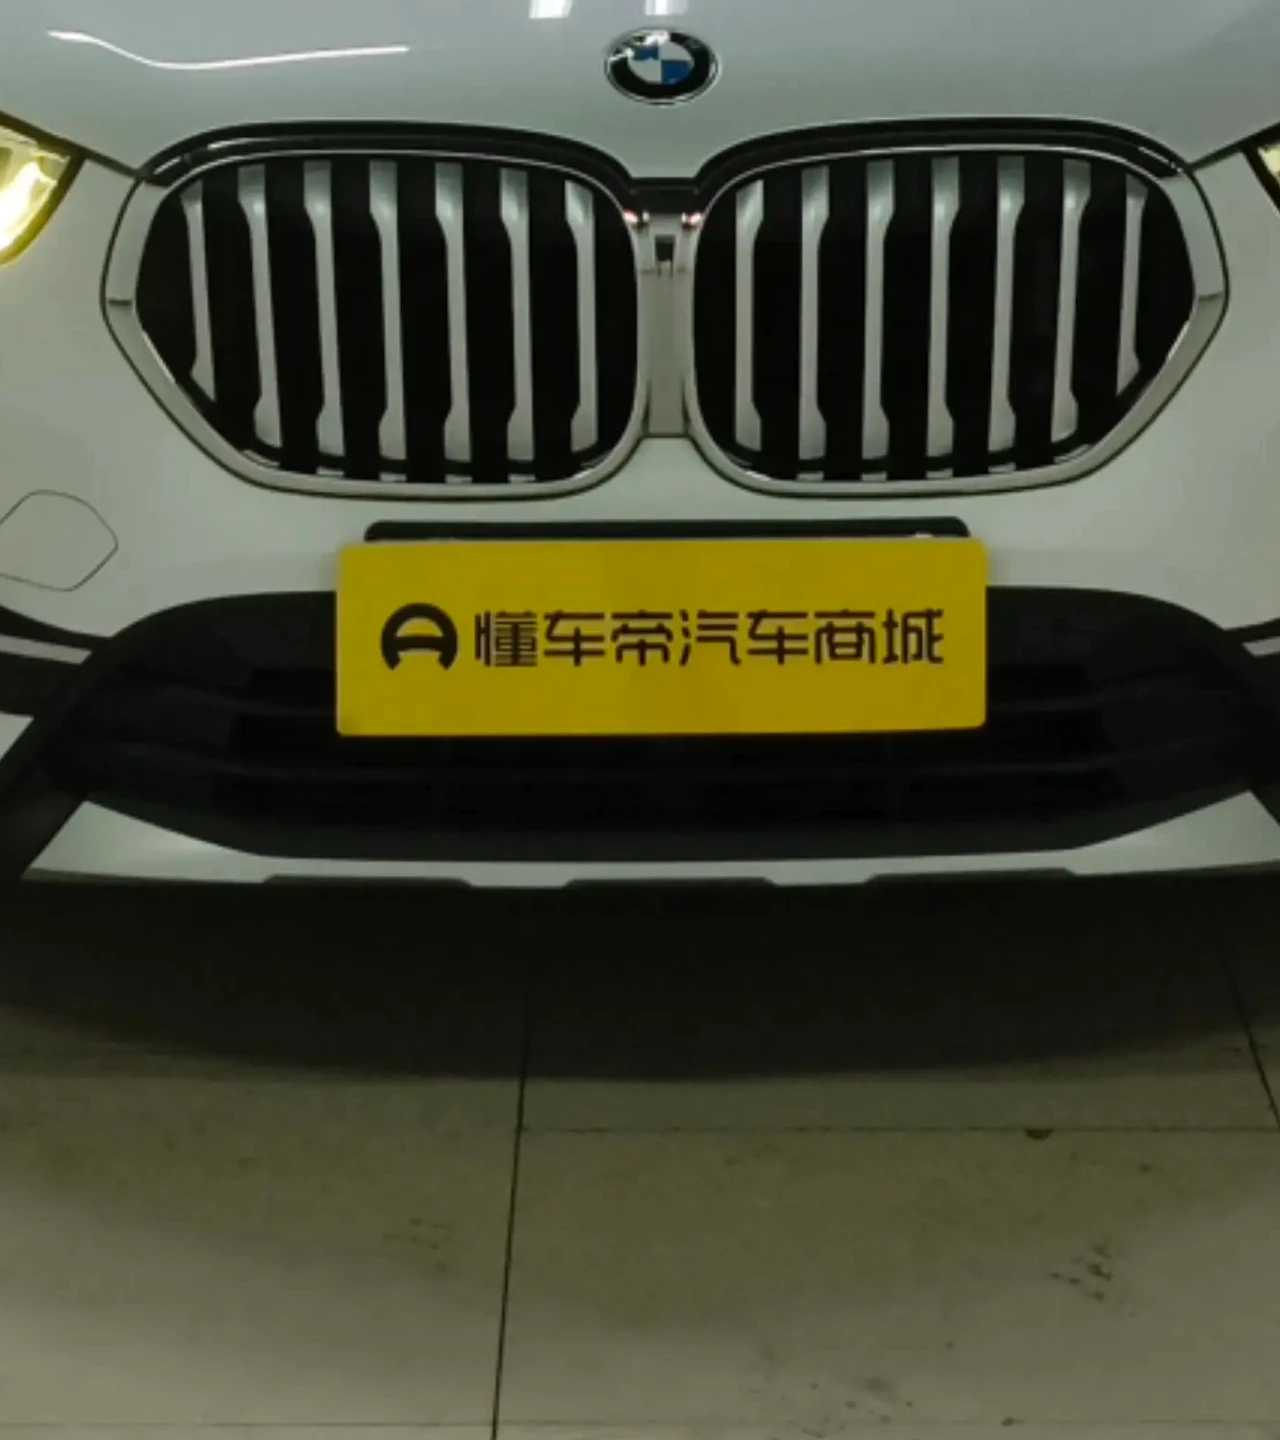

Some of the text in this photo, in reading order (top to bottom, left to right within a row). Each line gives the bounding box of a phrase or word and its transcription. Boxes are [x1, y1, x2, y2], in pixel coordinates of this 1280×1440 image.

[474, 607, 945, 667] 懂车帝汽车商城
